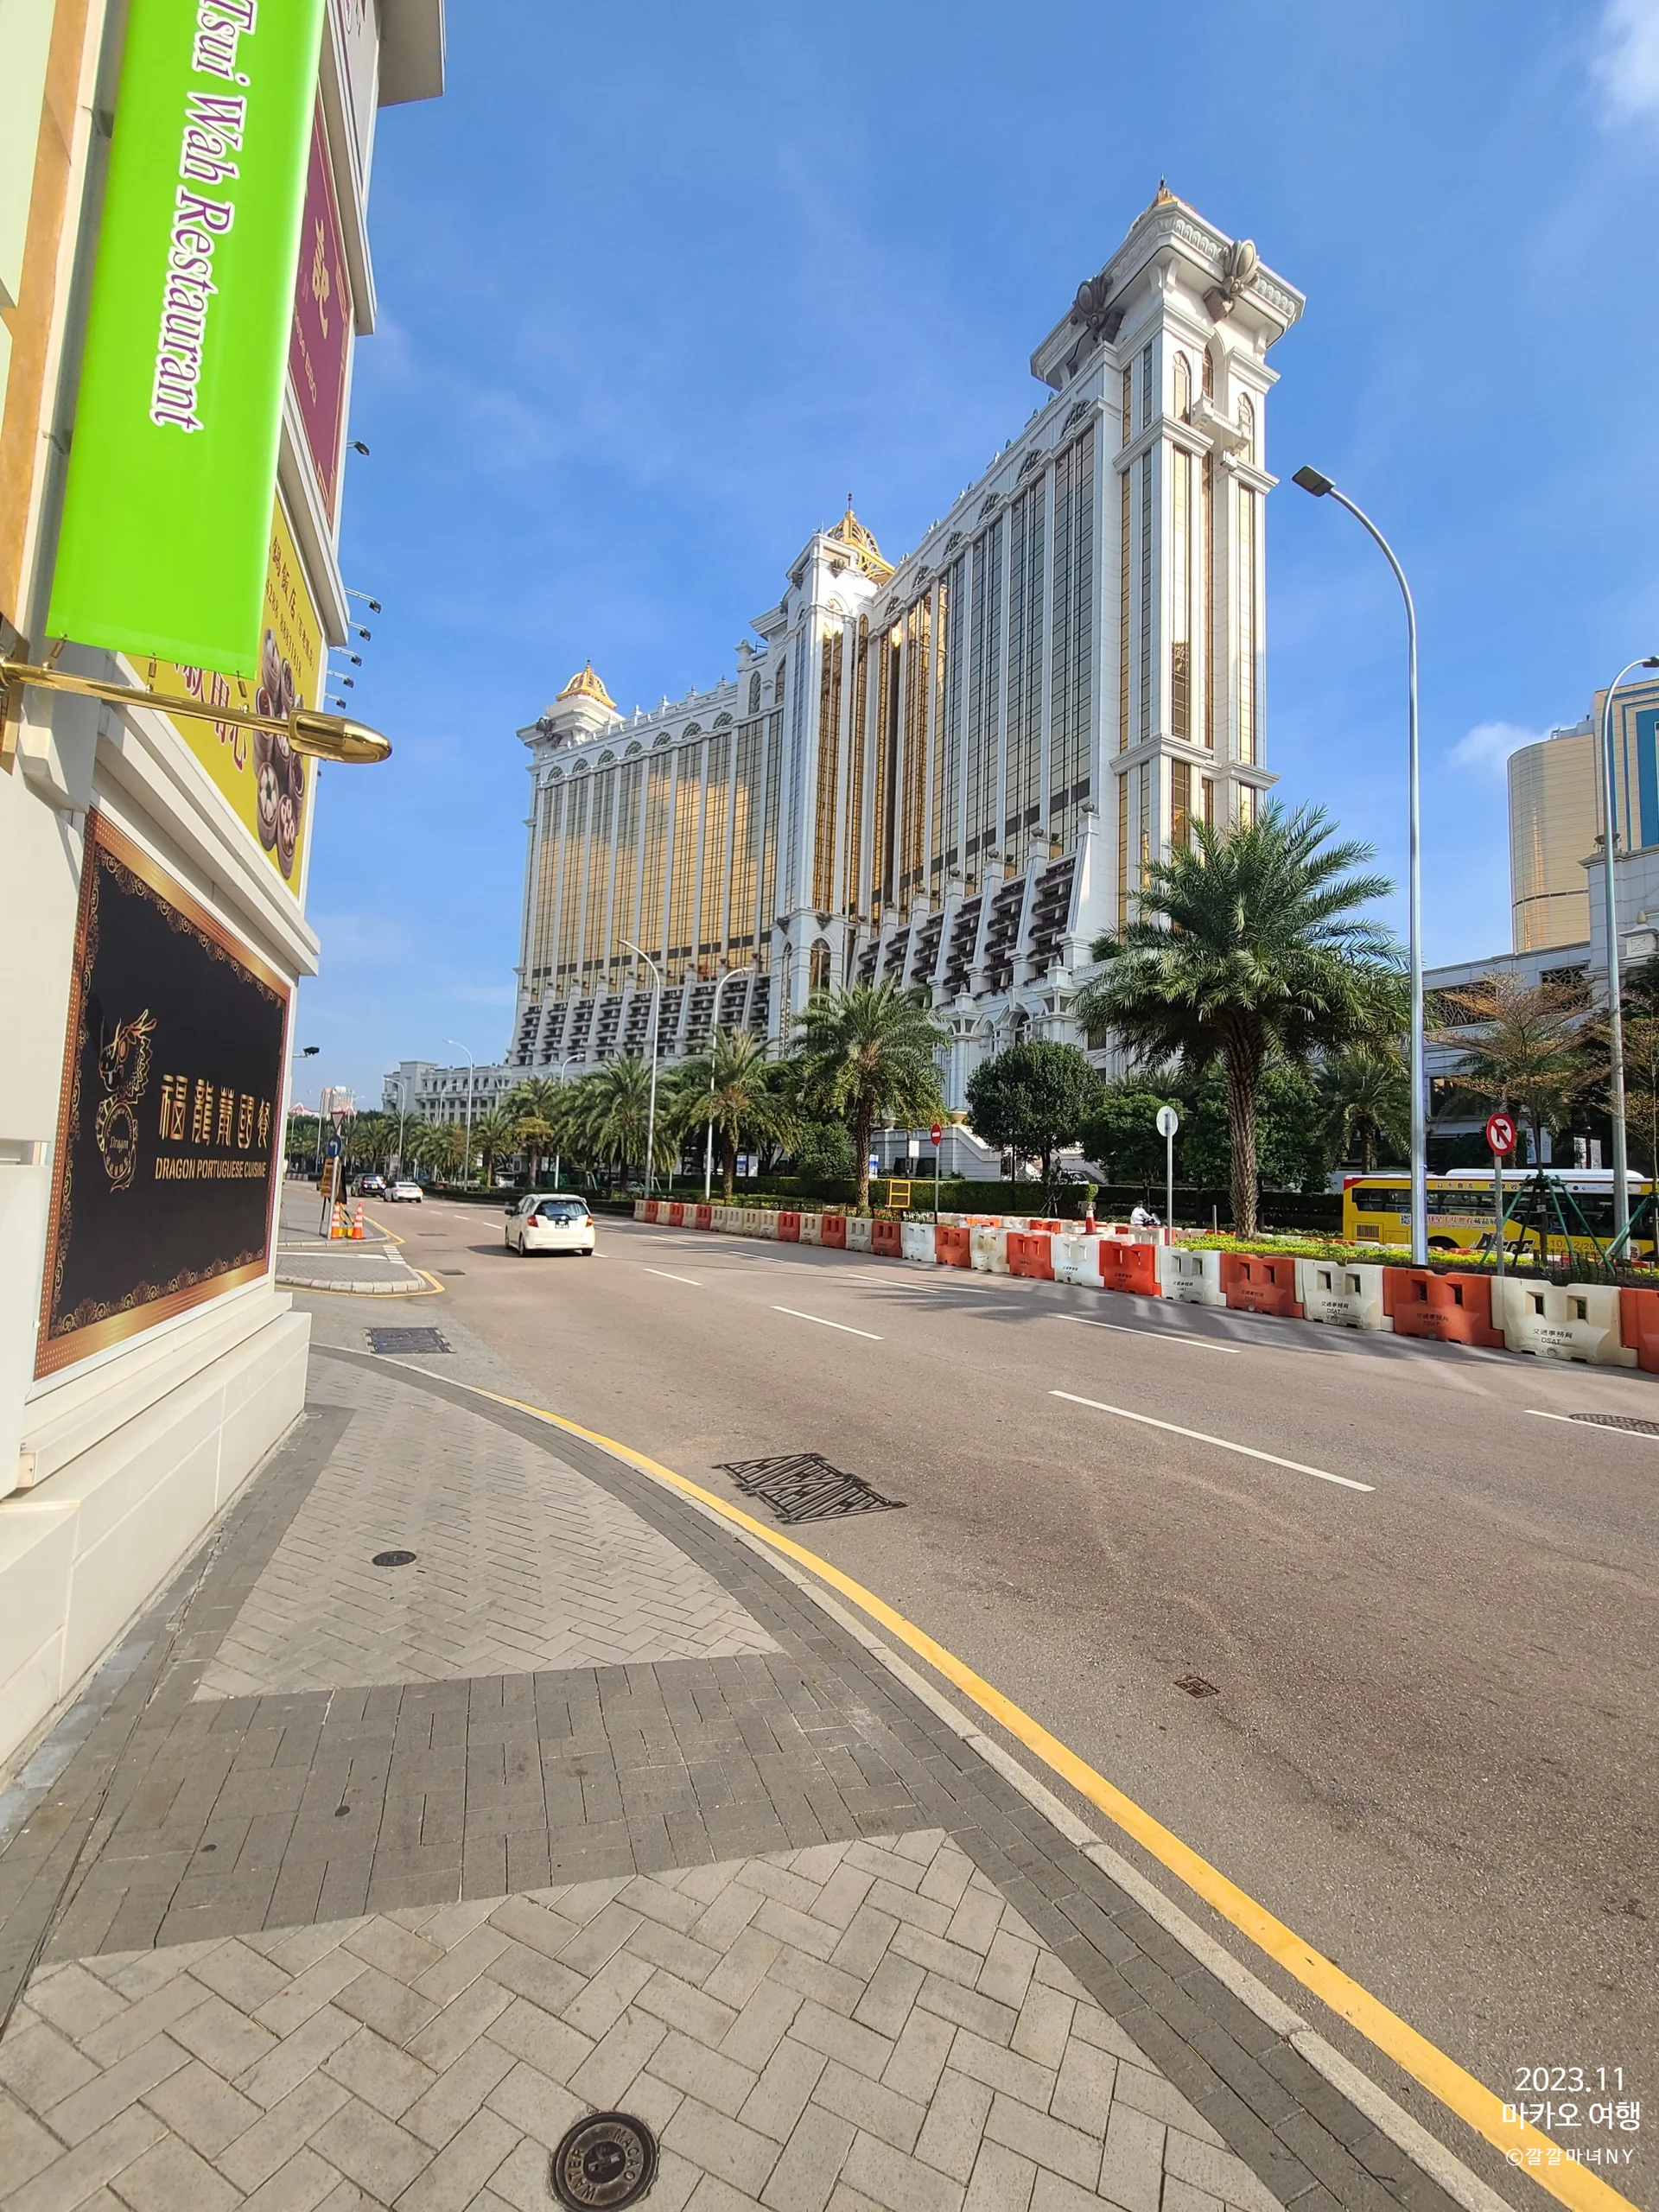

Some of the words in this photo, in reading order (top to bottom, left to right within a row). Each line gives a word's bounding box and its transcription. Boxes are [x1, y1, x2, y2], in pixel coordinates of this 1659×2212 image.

[194, 0, 256, 85] Tsui
[181, 92, 245, 182] Wah
[152, 187, 232, 430] Restaurant
[159, 1074, 270, 1149] 福龍葡國餐
[155, 1158, 195, 1179] DRAGON
[196, 1160, 243, 1179] PORTUGUESE
[244, 1161, 266, 1178] CUISINE
[1476, 1233, 1534, 1254] ACC
[1533, 1328, 1573, 1338] 交通事務局
[567, 2148, 596, 2201] WATER
[613, 2128, 640, 2182] MACAO
